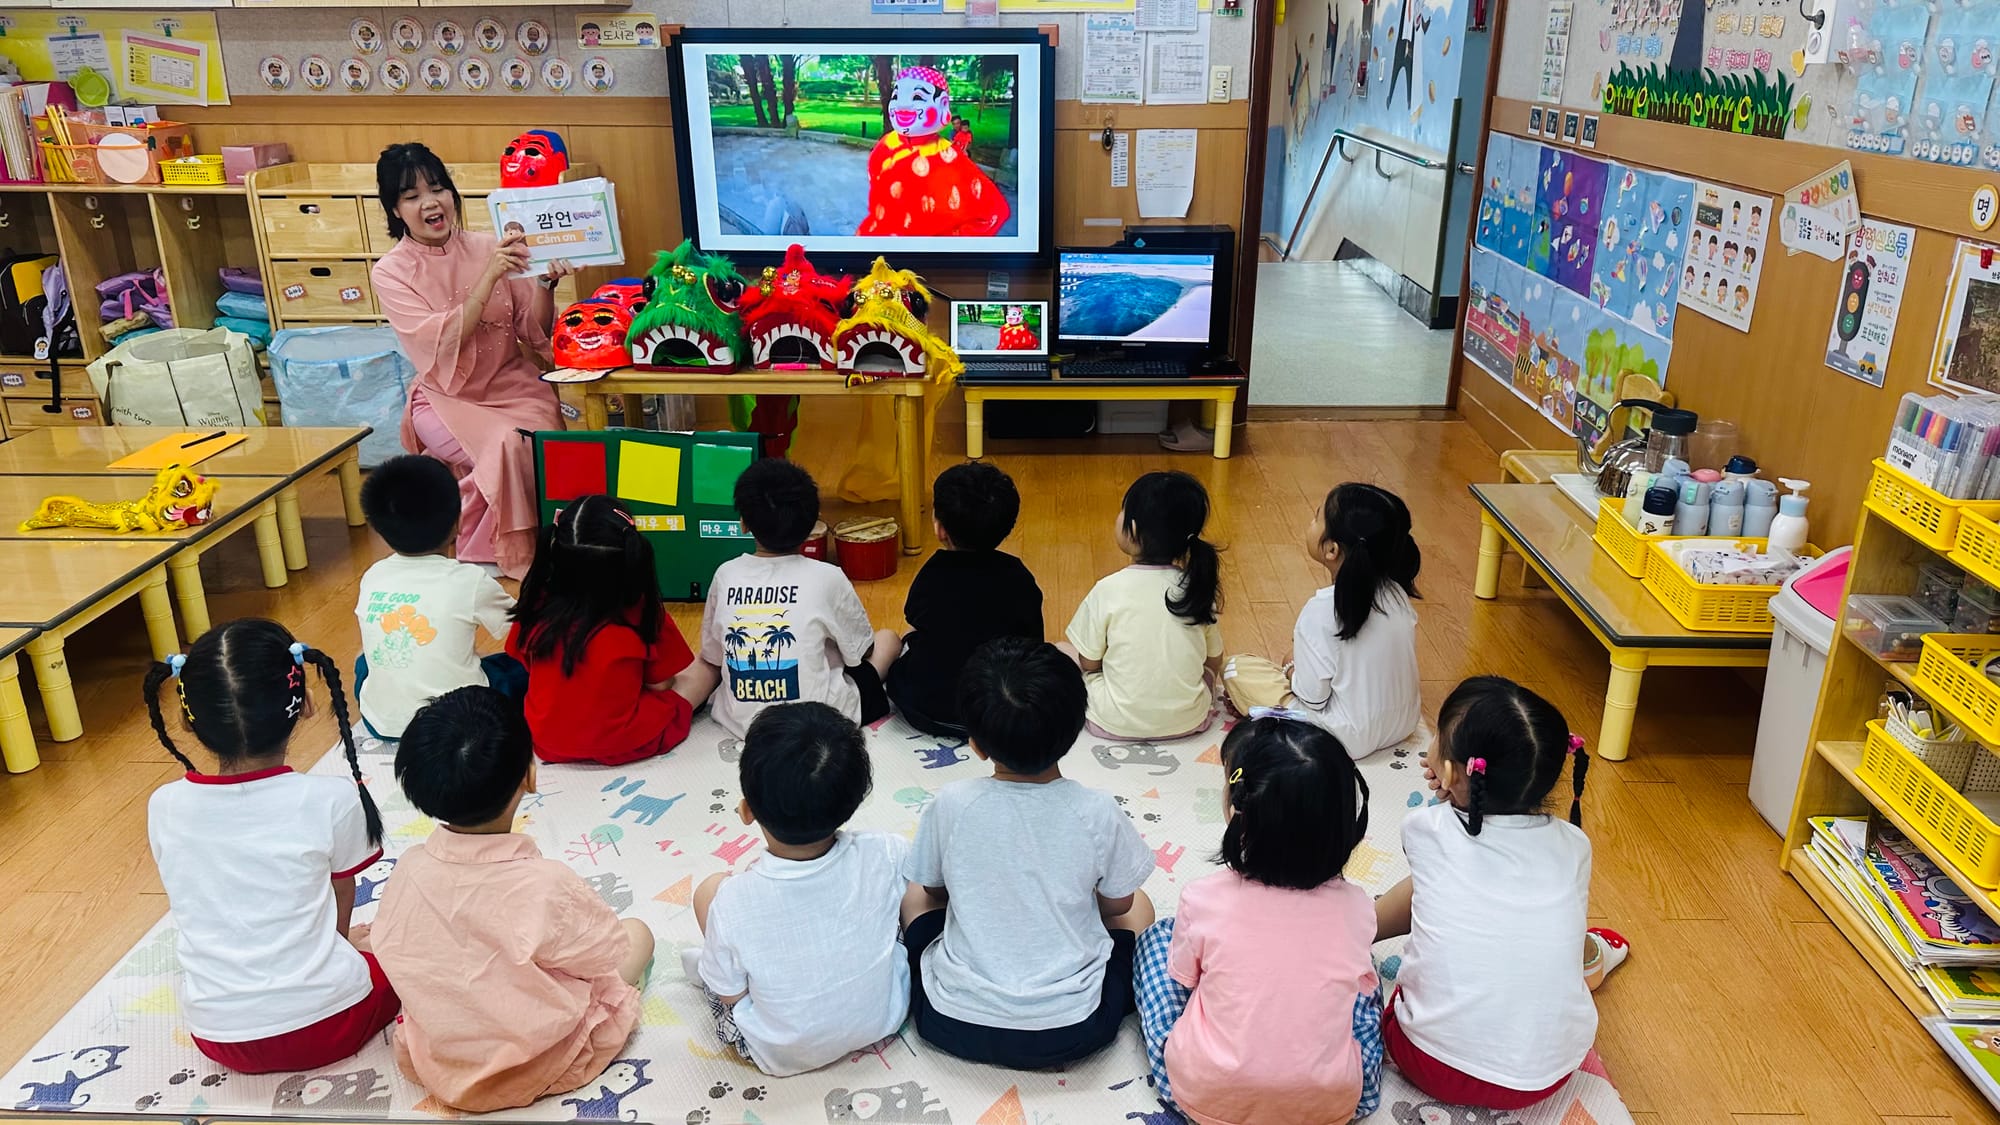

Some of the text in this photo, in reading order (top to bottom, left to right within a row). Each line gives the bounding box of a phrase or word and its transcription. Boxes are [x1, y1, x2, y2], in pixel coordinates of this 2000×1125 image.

[609, 20, 627, 29] 작은
[603, 30, 634, 40] 도서관
[1977, 196, 1990, 221] 명
[536, 211, 573, 229] 깜언
[536, 232, 576, 244] Cảm ơn
[1814, 223, 1840, 246] 정리해요
[1855, 225, 1908, 258] 감정신호등
[116, 407, 132, 417] with
[134, 413, 152, 425] two
[198, 415, 230, 426] Winnie
[635, 518, 659, 529] 마우
[702, 523, 739, 536] 마우 싼
[369, 591, 421, 604] THE GOOD
[727, 586, 798, 605] PARADISE
[736, 678, 787, 699] BEACH
